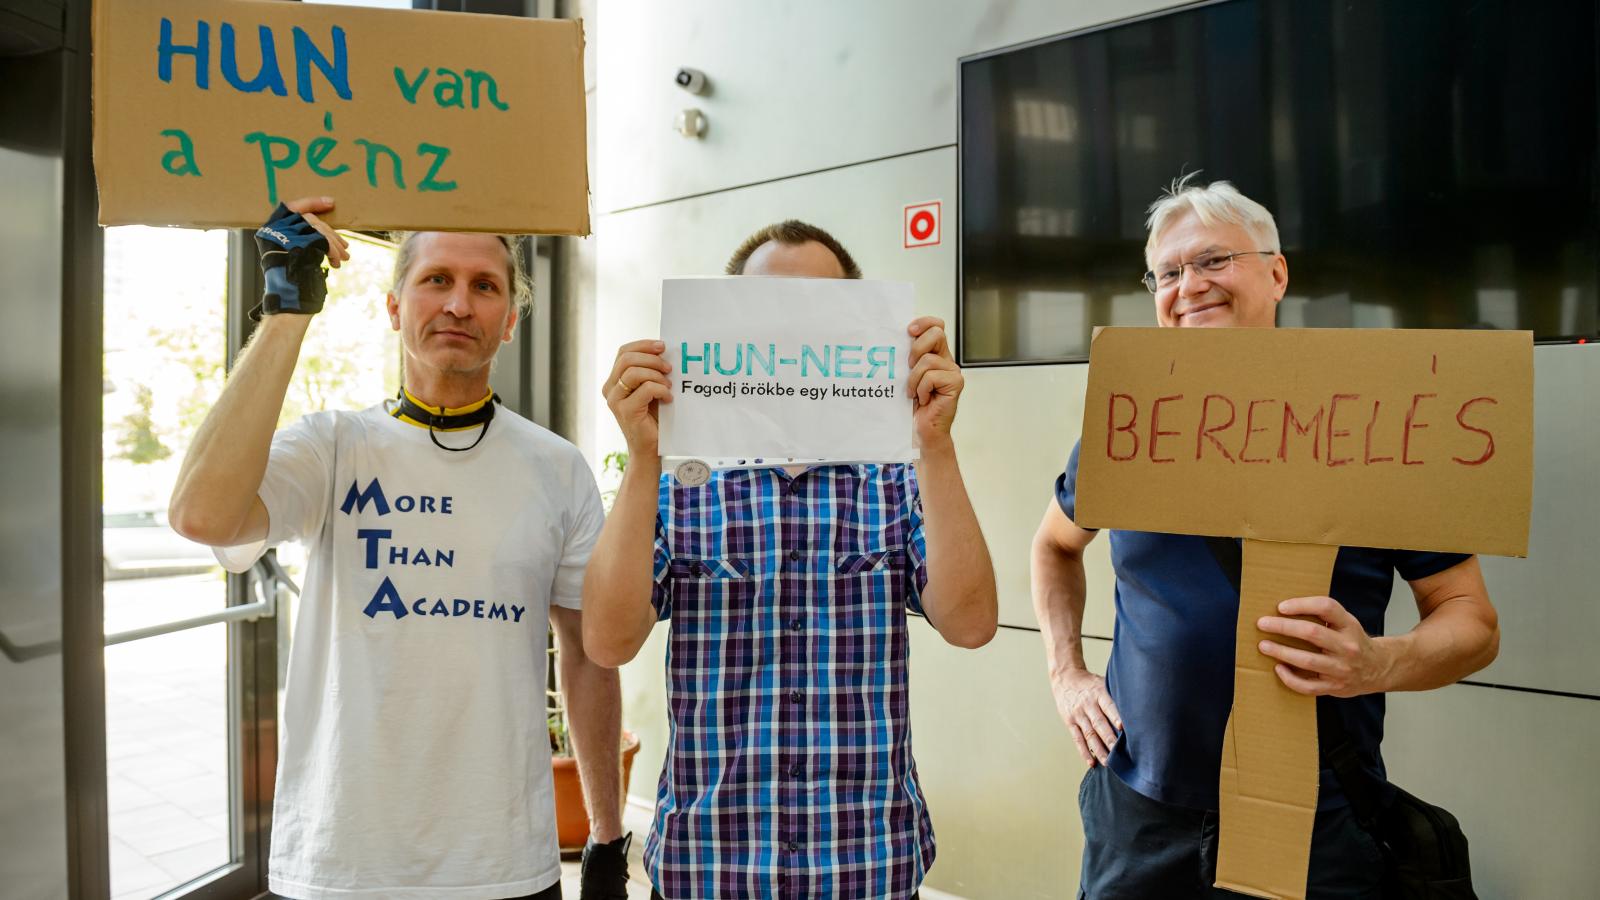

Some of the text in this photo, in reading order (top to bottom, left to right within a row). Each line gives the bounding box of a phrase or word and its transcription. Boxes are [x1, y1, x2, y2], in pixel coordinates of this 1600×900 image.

[158, 17, 510, 111] HUN van
[160, 111, 459, 206] a pénz
[681, 380, 894, 400] Fogadj örökbe egy kutatót!
[1105, 353, 1499, 468] BÉREMELÉS
